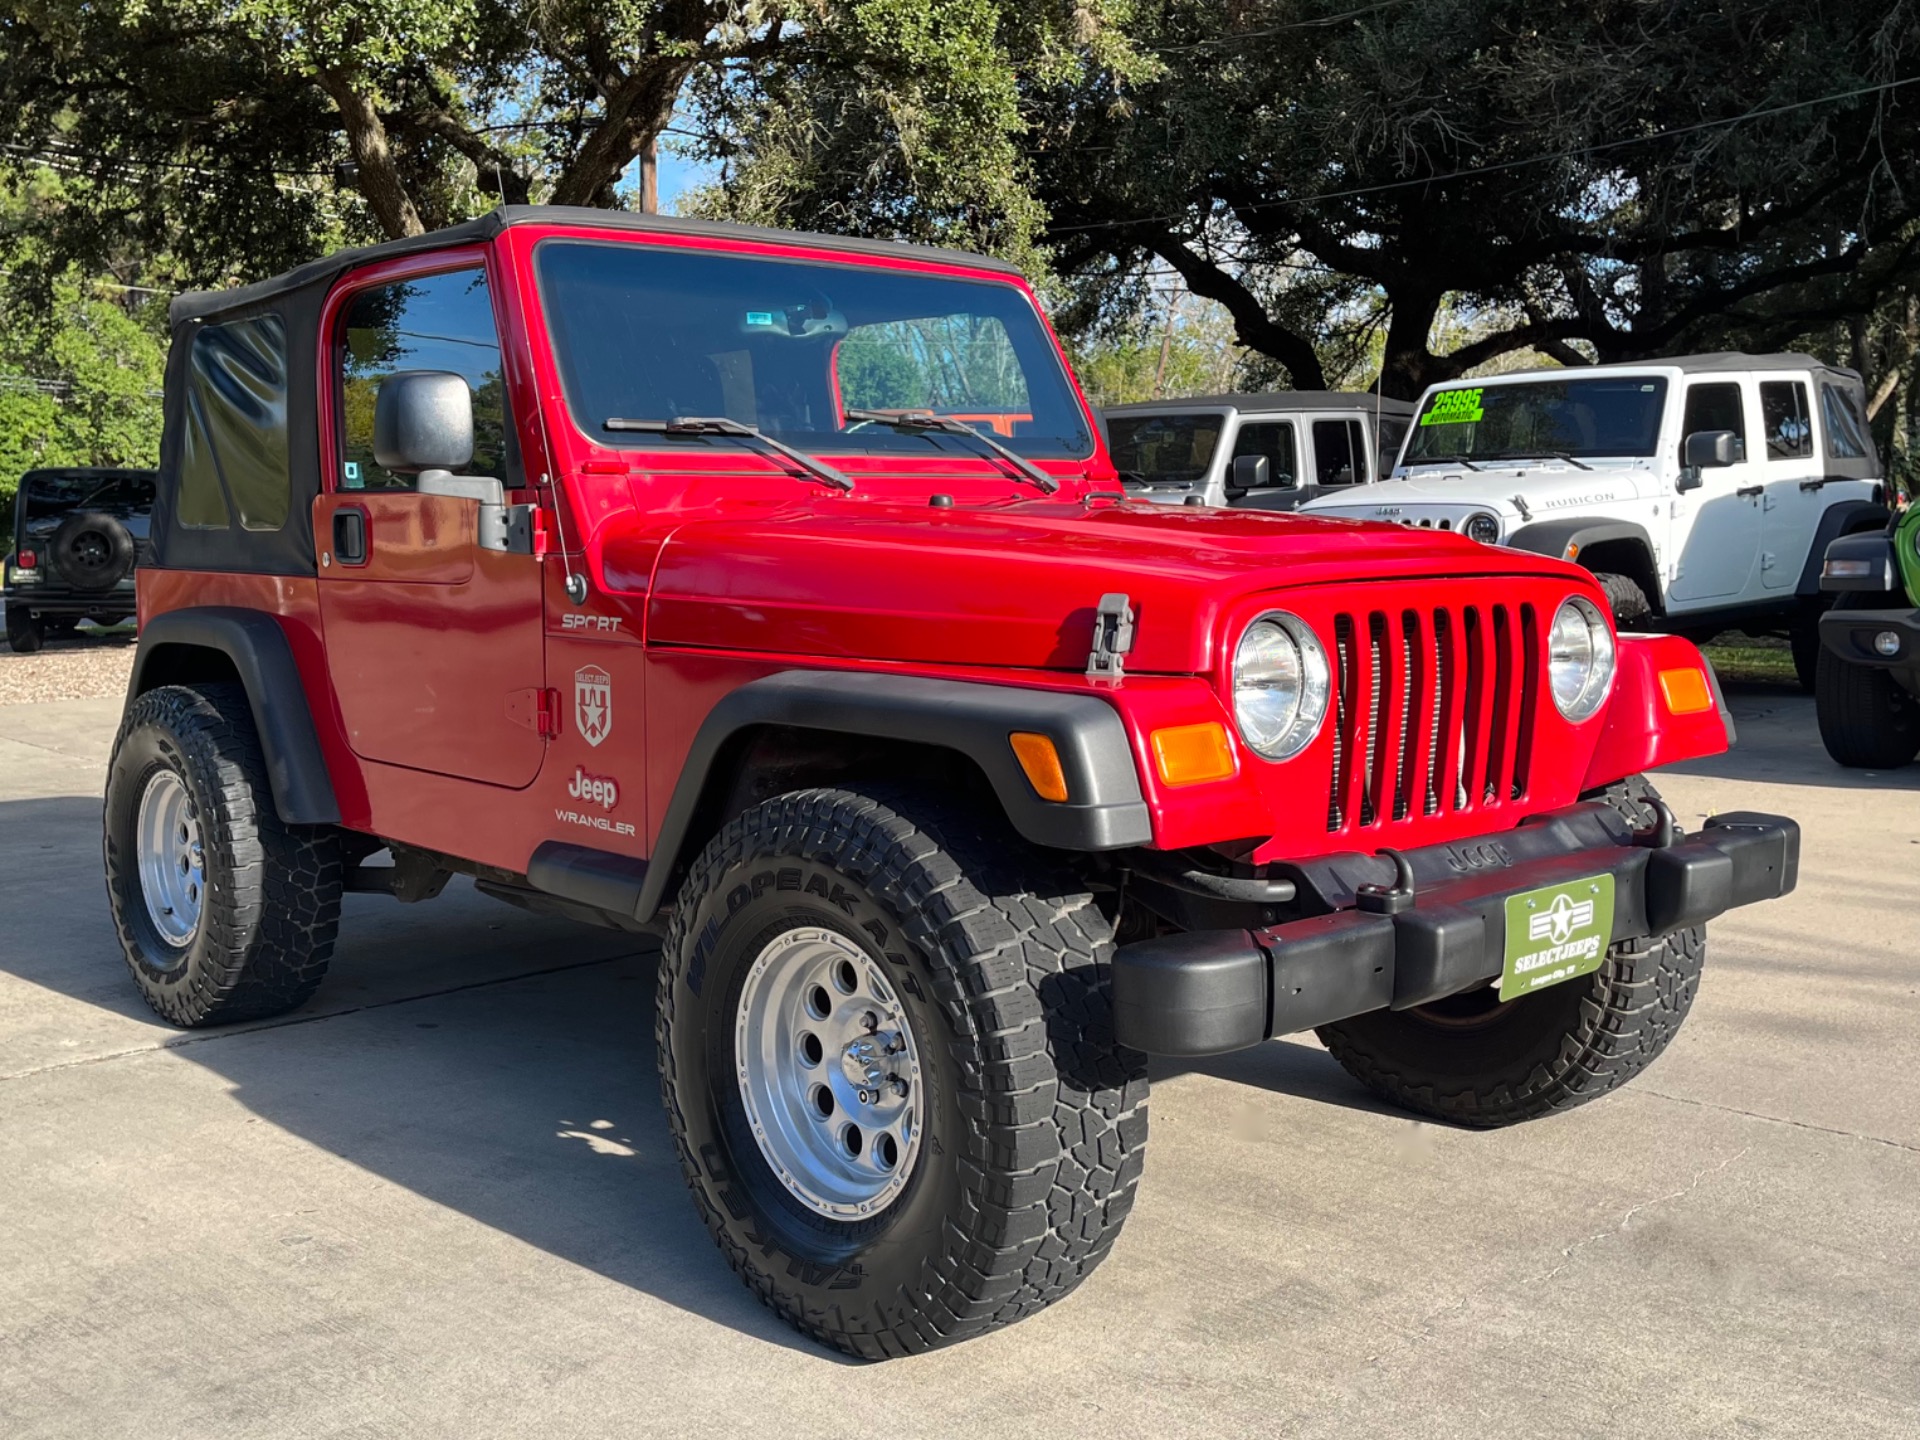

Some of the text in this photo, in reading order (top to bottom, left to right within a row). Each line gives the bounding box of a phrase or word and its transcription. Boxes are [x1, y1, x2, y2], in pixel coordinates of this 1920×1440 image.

[1434, 388, 1484, 413] 25995
[1429, 411, 1474, 423] AUTOMATIC
[1545, 492, 1615, 508] RUBICON
[568, 769, 616, 808] Jeep
[555, 809, 635, 837] WRANGLER
[1445, 841, 1512, 872] Jeep
[687, 867, 862, 999] WILDPEAK
[1514, 935, 1600, 974] SELECTJEEPS
